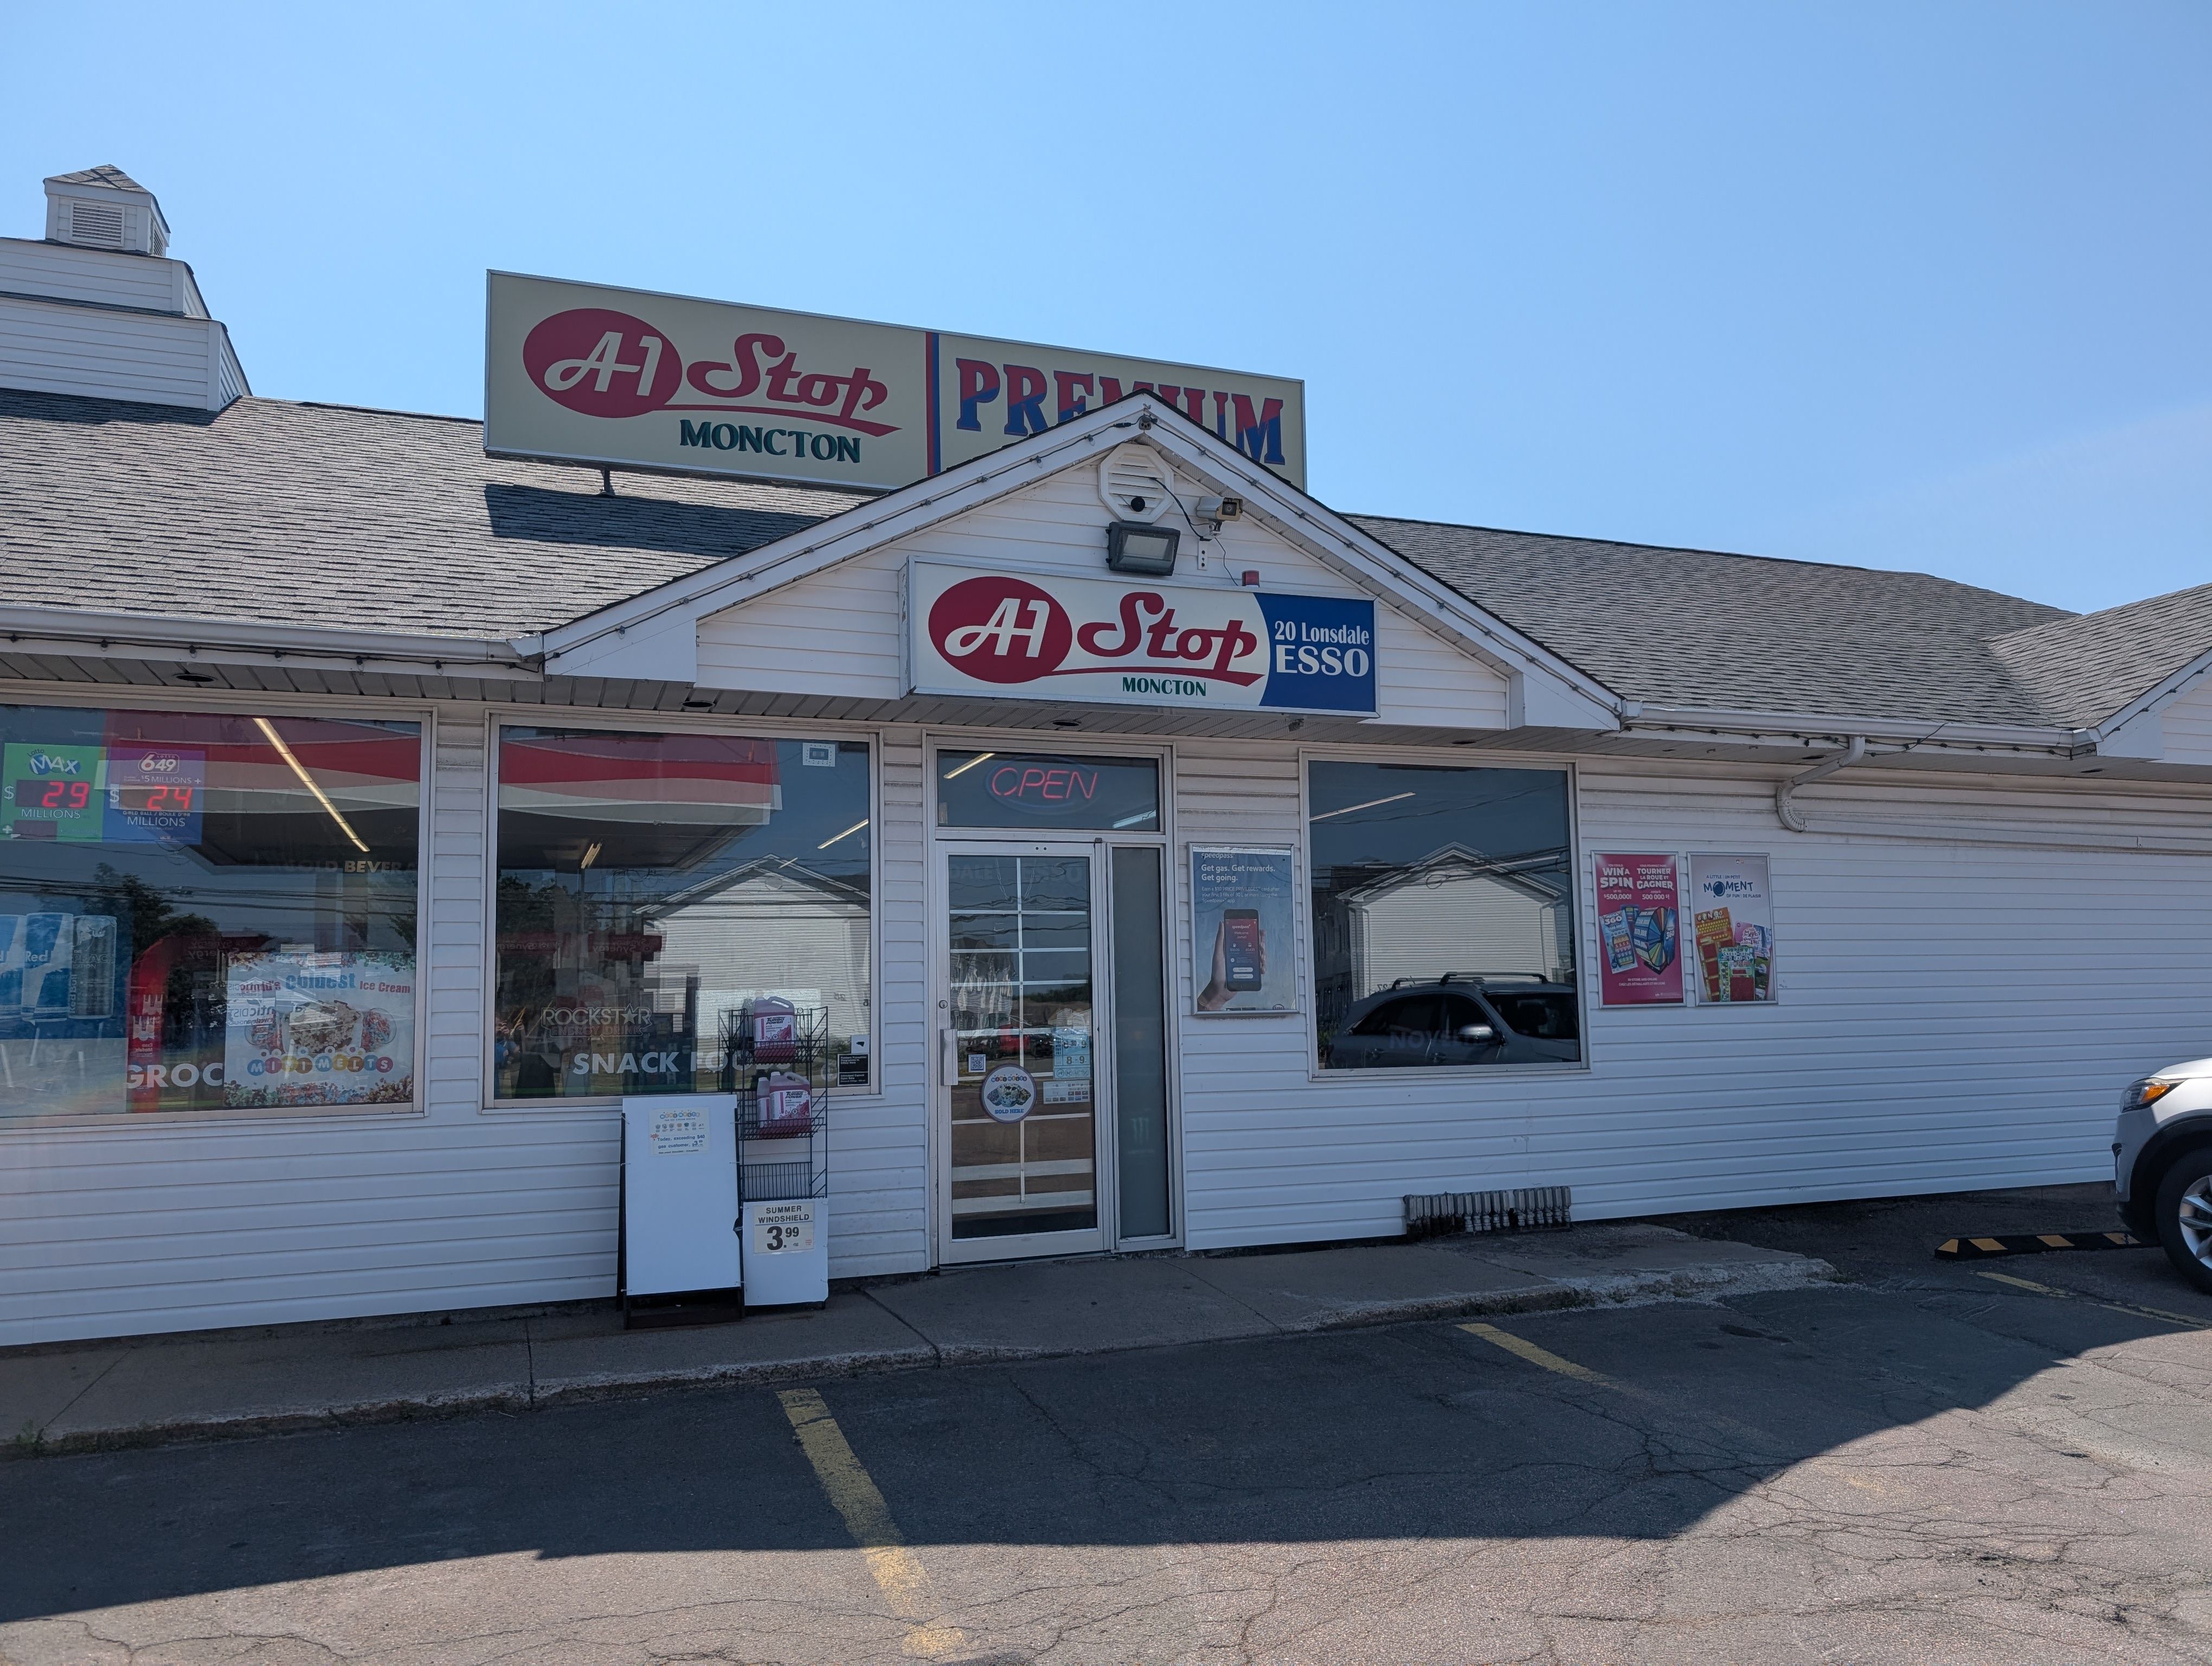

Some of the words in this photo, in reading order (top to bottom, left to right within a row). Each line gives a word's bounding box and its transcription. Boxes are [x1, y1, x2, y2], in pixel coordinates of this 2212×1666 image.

[686, 333, 888, 419] Stop
[680, 420, 861, 463] MONCTON
[1077, 592, 1257, 671] Stop
[1275, 620, 1296, 640] 20
[1302, 622, 1369, 645] Lonsdale
[1276, 644, 1369, 677] ESSO
[1122, 676, 1207, 696] MONCTON
[27, 749, 44, 757] Lotto
[992, 767, 1098, 799] OPEN
[4, 785, 14, 800] $
[42, 781, 90, 808] 29
[147, 785, 192, 810] 24
[1216, 865, 1230, 873] gas.
[1602, 868, 1624, 876] WIN
[1216, 873, 1238, 883] going.
[1600, 877, 1634, 889] SPIN
[1636, 881, 1674, 890] GAGNER
[1703, 881, 1753, 896] MOMENT
[1605, 915, 1623, 925] 360
[1666, 930, 1675, 939] 360
[26, 950, 48, 962] Red
[359, 981, 375, 991] Ice
[378, 982, 410, 994] Cream
[316, 1056, 391, 1072] MELTS
[573, 1052, 680, 1075] SNACK
[1066, 1056, 1072, 1065] 8
[1079, 1055, 1085, 1064] 9
[766, 1205, 802, 1214] SUMMER
[758, 1214, 809, 1223] WINDSHIELD
